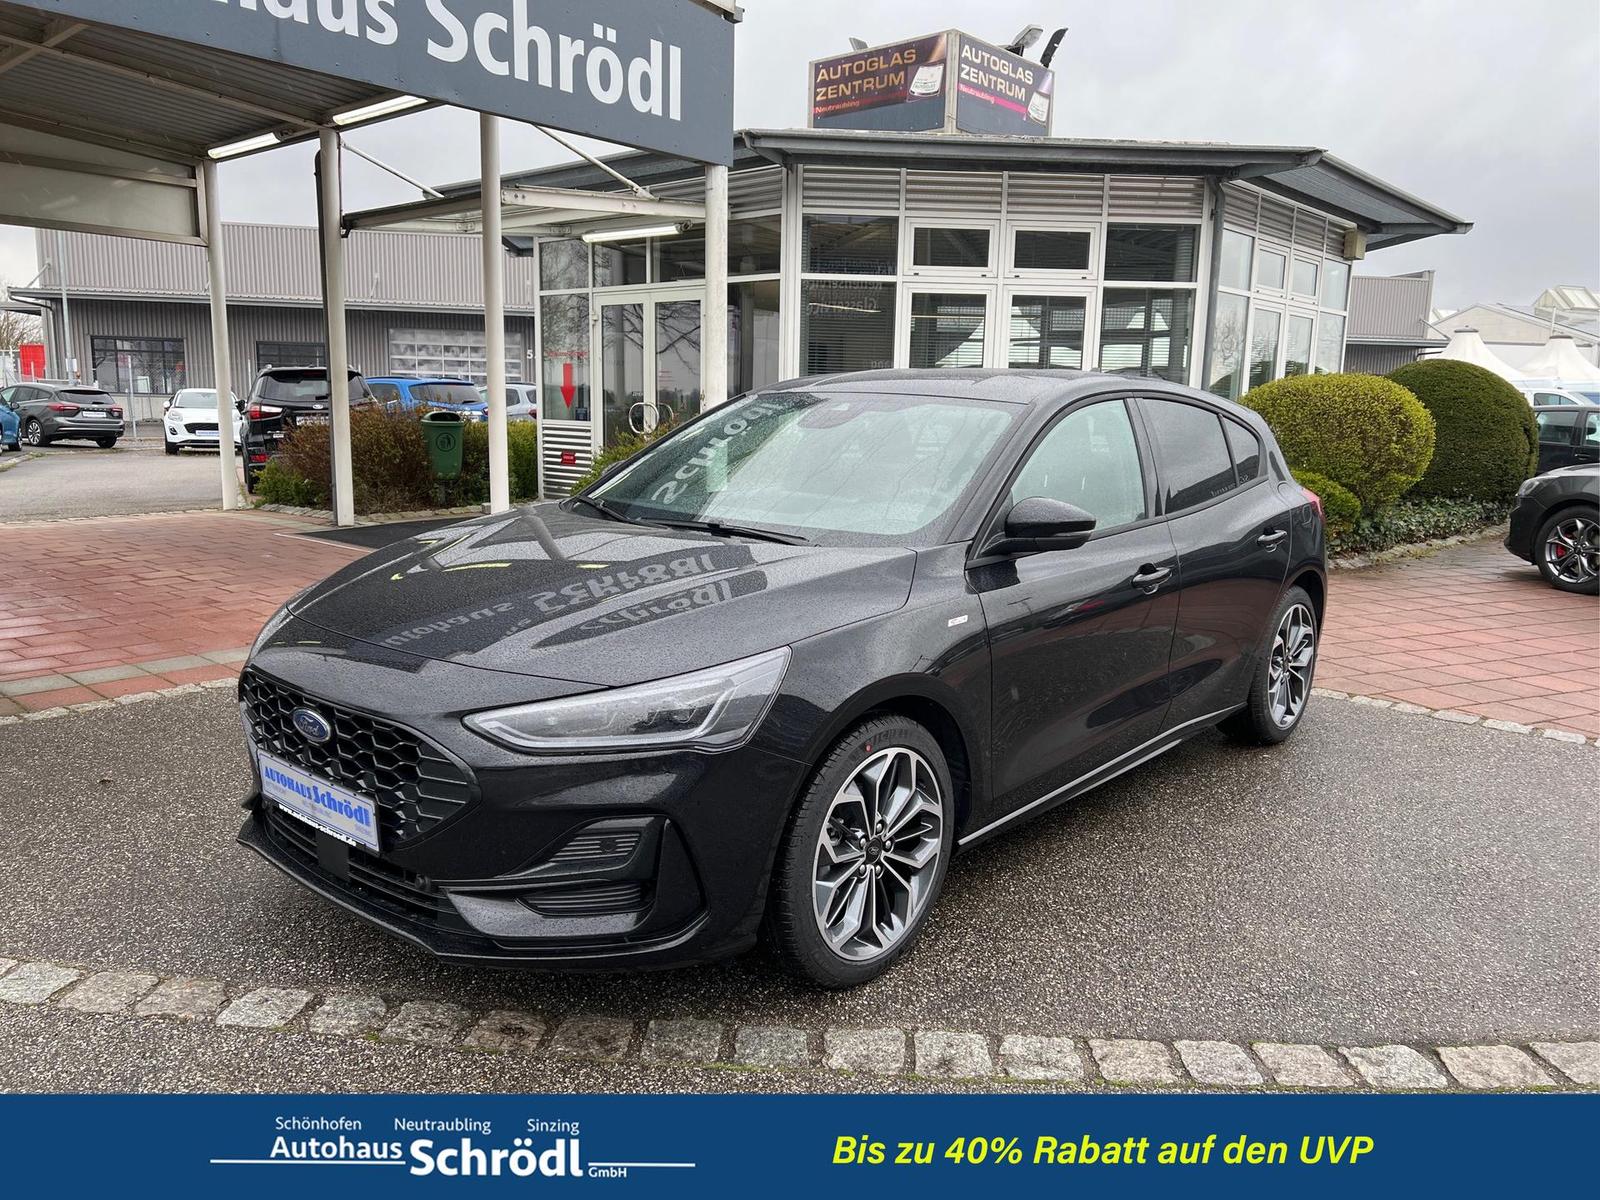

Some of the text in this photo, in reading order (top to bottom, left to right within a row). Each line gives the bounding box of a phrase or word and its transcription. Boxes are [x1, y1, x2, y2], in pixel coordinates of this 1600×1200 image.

[425, 0, 682, 121] Schrödl
[816, 49, 917, 83] AUTOGLAS
[961, 43, 1033, 86] AUTOGLAS
[815, 71, 905, 102] ZENTRUM
[959, 83, 995, 105] Neutraubling
[960, 63, 1026, 102] ZENTRUM
[815, 99, 861, 114] Neutraubling
[298, 714, 320, 738] Ford
[264, 766, 312, 800] AUTOHAUS
[312, 785, 371, 827] Schrödl
